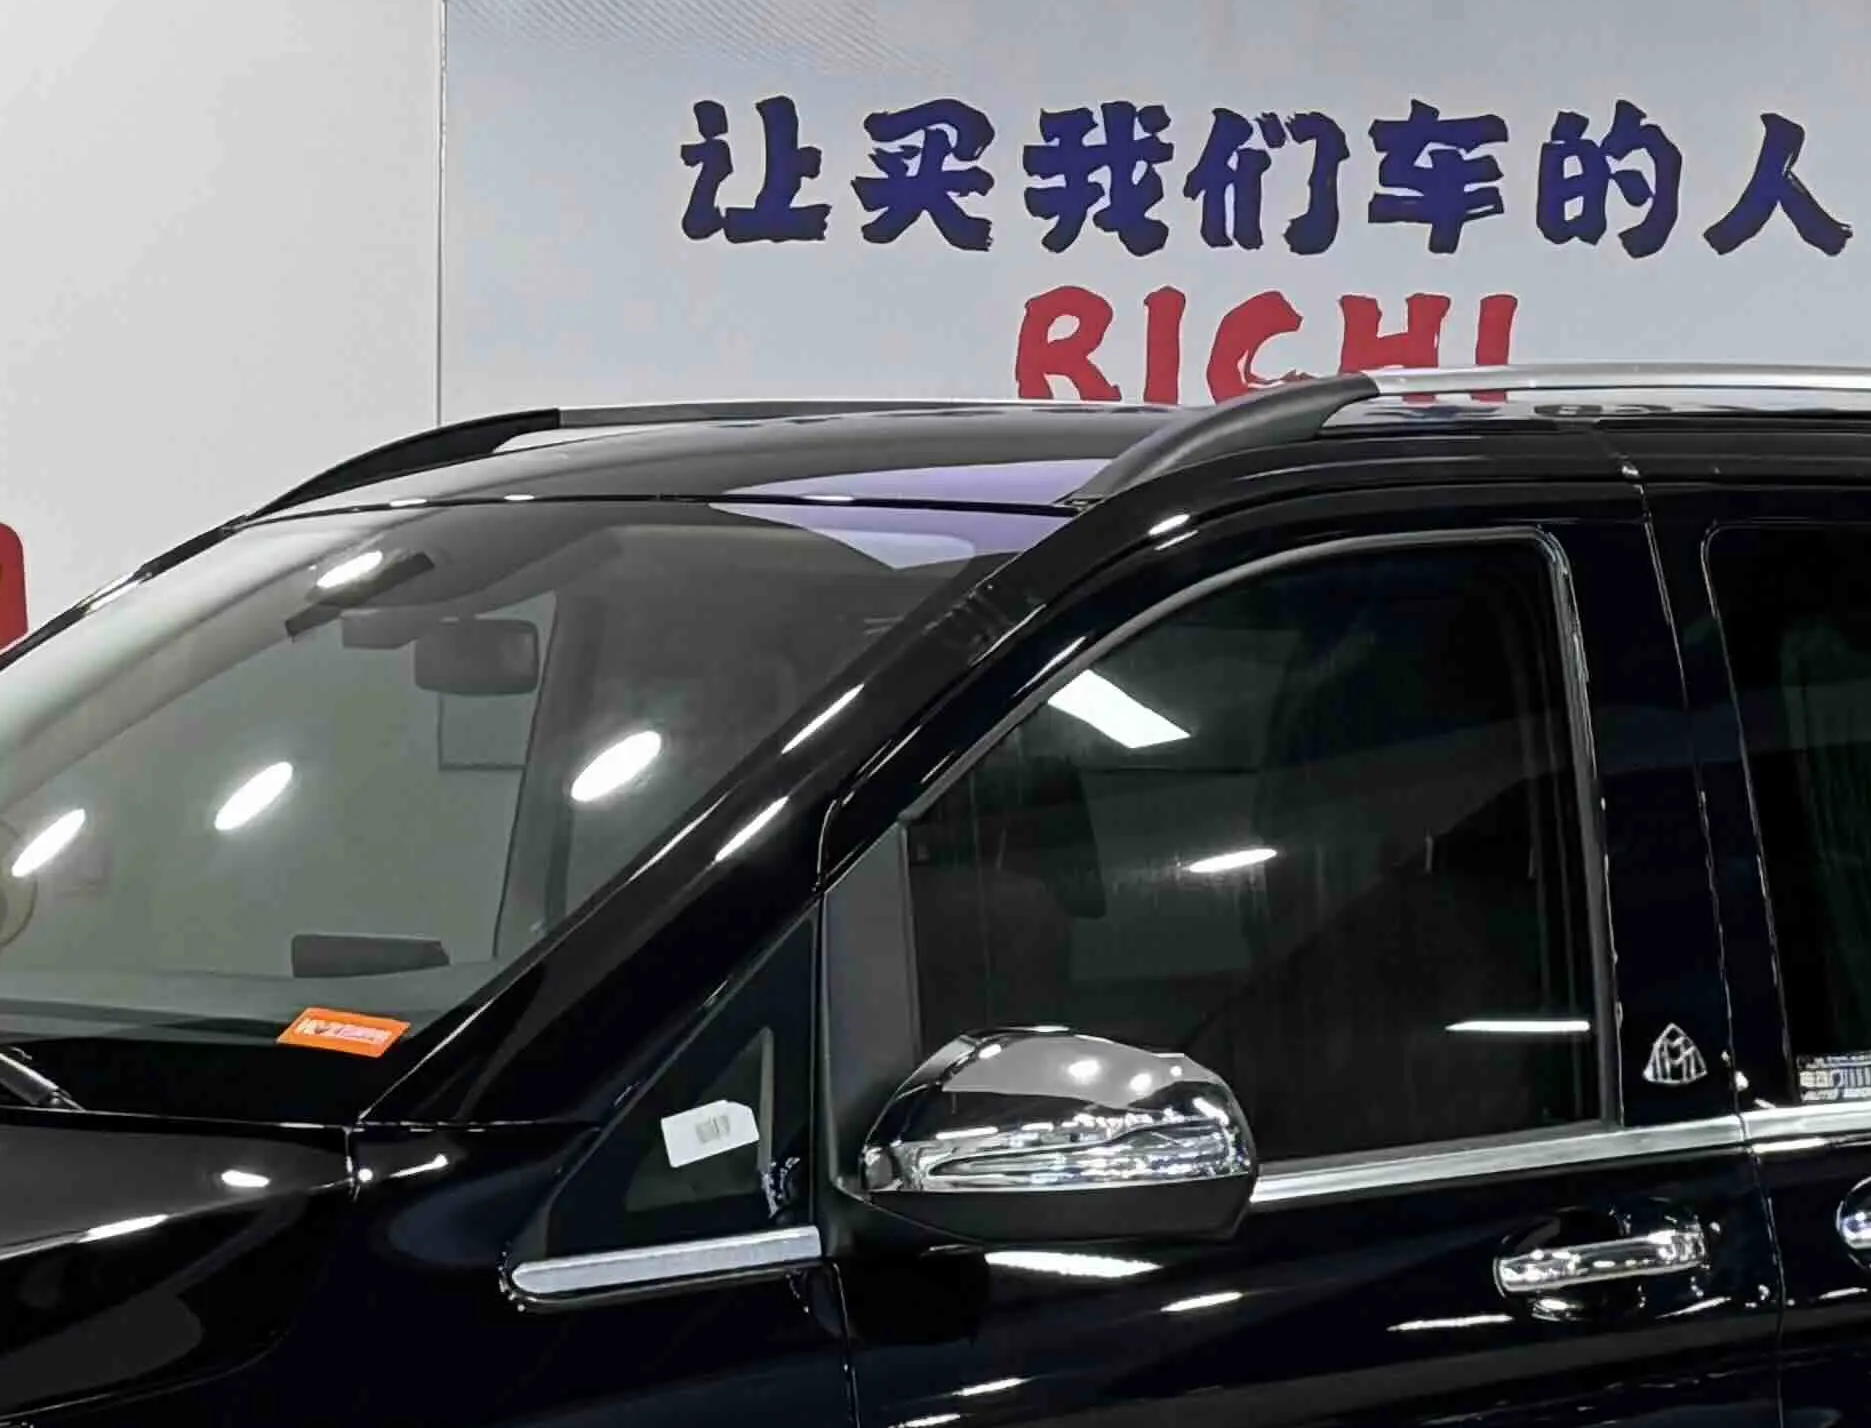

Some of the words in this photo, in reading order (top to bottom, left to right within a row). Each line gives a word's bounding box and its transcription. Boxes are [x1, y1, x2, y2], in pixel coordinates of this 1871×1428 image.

[680, 95, 1854, 259] 让买我们车的人
